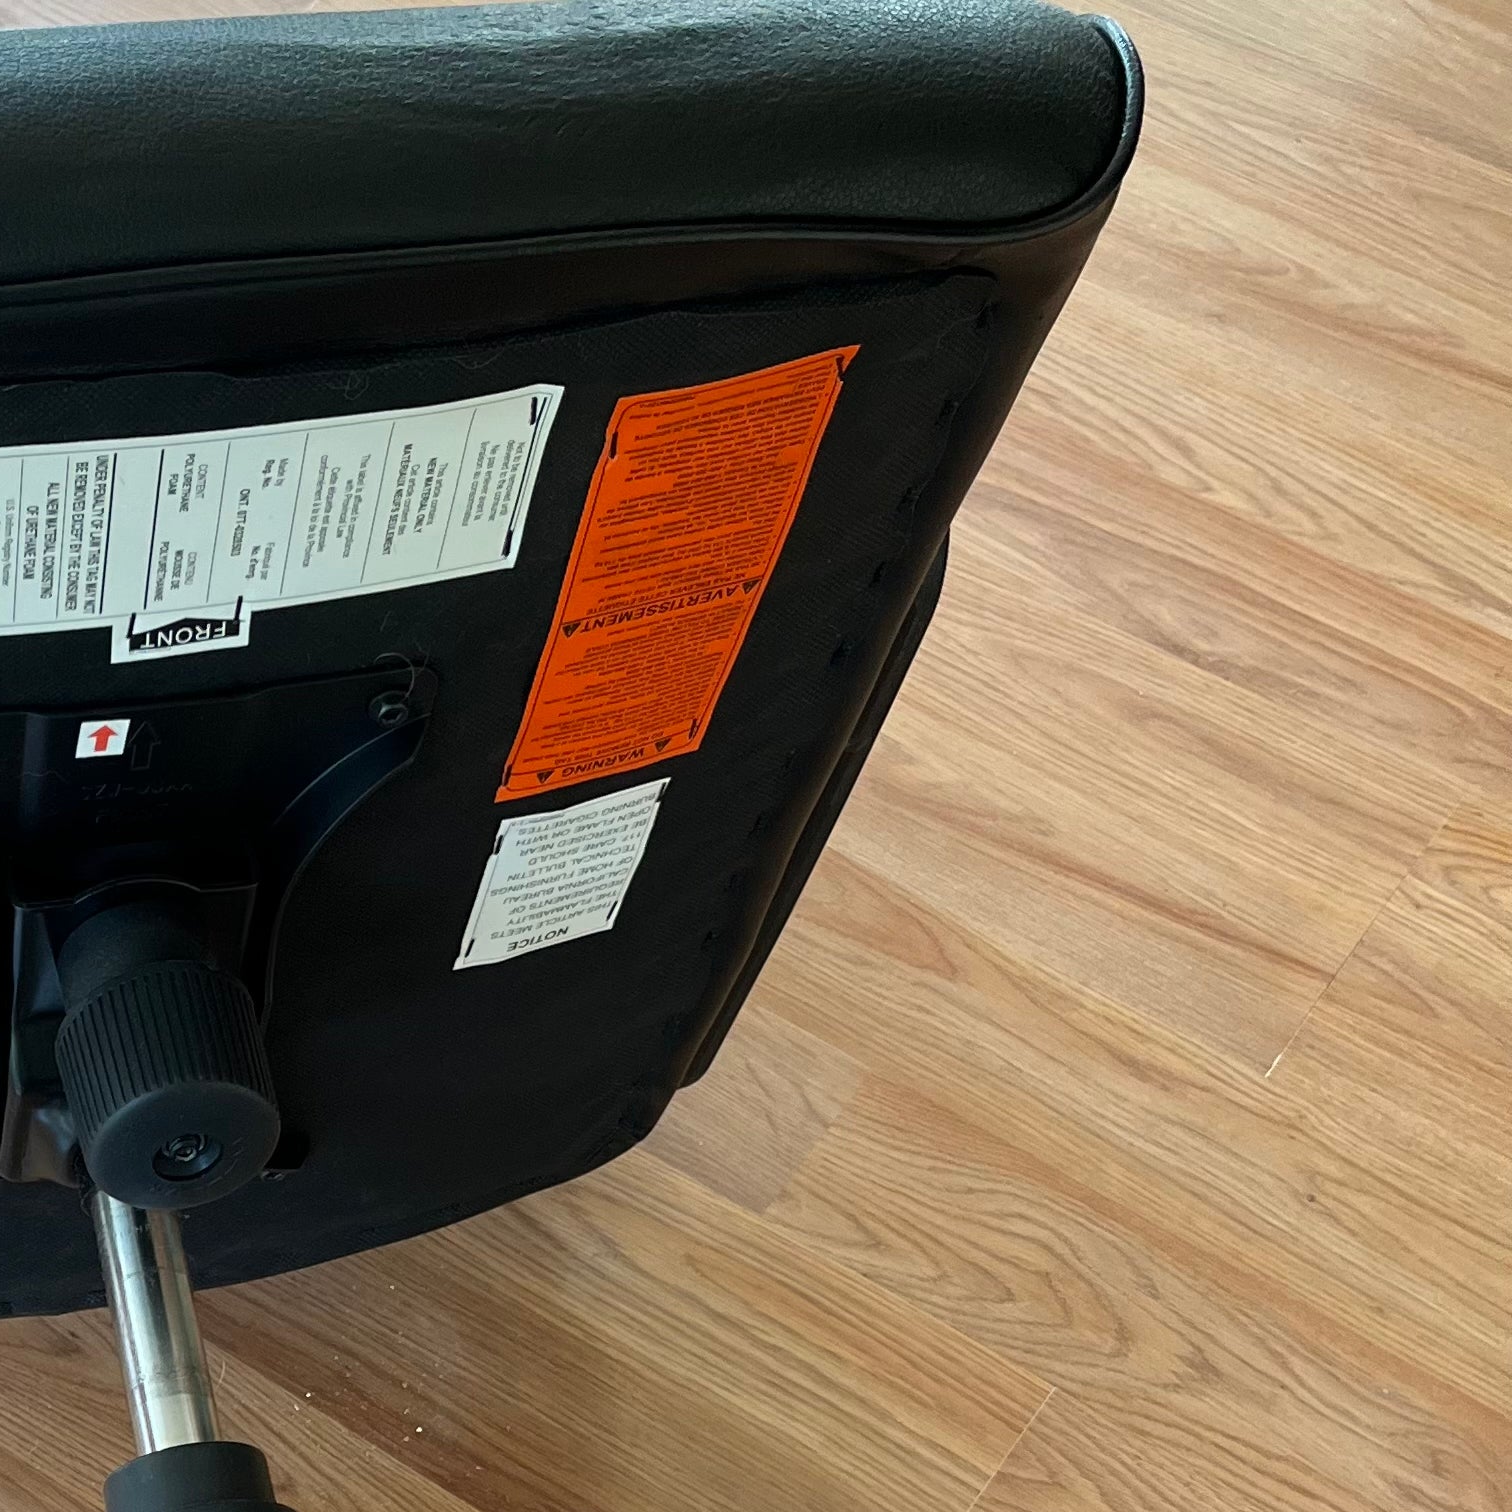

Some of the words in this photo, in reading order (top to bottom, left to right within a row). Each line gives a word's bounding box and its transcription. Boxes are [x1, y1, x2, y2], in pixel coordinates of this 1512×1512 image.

[75, 461, 88, 472] BE
[94, 454, 108, 481] UNDER
[426, 457, 437, 474] NEW
[46, 482, 60, 496] ALL
[167, 473, 178, 494] FOAM
[179, 453, 195, 512] POLYURETHANE
[195, 464, 208, 498] CONTENT
[72, 474, 87, 511] REMOVED
[92, 483, 106, 516] PENALTY
[417, 476, 433, 512] MATERIAL
[26, 505, 39, 515] OF
[46, 498, 58, 515] NEW
[70, 513, 84, 541] EXCEPT
[90, 519, 103, 529] OF
[413, 513, 425, 532] ONLY
[23, 518, 38, 557] URETHANE
[43, 517, 57, 554] MATERIAL
[89, 531, 101, 547] LAW
[69, 543, 82, 552] BY
[87, 549, 100, 565] THIS
[22, 558, 35, 579] FOAM
[67, 554, 81, 569] THE
[171, 549, 183, 578] MOUSSE
[184, 551, 197, 584] CONTENU
[40, 555, 54, 598] CONSISTING
[85, 566, 99, 581] TAG
[64, 571, 79, 610] CONSUMER
[85, 582, 96, 596] MAY
[170, 579, 180, 590] DE
[83, 599, 95, 613] NOT
[580, 585, 738, 632] AVERTISSEMENT
[140, 620, 226, 649] FRONT
[561, 747, 644, 777] WARNING
[601, 792, 655, 816] BURNING
[616, 805, 651, 822] OPEN
[518, 811, 598, 835] CIGARETTES
[573, 817, 614, 833] FLAME
[631, 818, 647, 828] BE
[515, 834, 548, 846] WITH
[551, 828, 567, 838] OR
[557, 824, 628, 847] EXERCISED
[519, 842, 554, 856] NEAR
[582, 837, 616, 851] CARE
[527, 846, 579, 865] SHOULD
[572, 843, 635, 865] TECHNICAL
[615, 855, 632, 866] OF
[506, 861, 566, 881] BULLETIN
[577, 860, 613, 876] HOME
[490, 870, 574, 896] FURNISHINGS
[557, 867, 628, 891] CALIFORNIA
[502, 886, 554, 904] BUREAU
[529, 878, 624, 910] REQUIREMENTS
[595, 889, 616, 901] THE
[506, 897, 592, 925] FLAMMABILITY
[508, 905, 526, 915] OF
[586, 900, 611, 913] THIS
[535, 908, 584, 929] ARTICLE
[490, 924, 533, 939] MEETS
[506, 926, 568, 951] NOTICE
